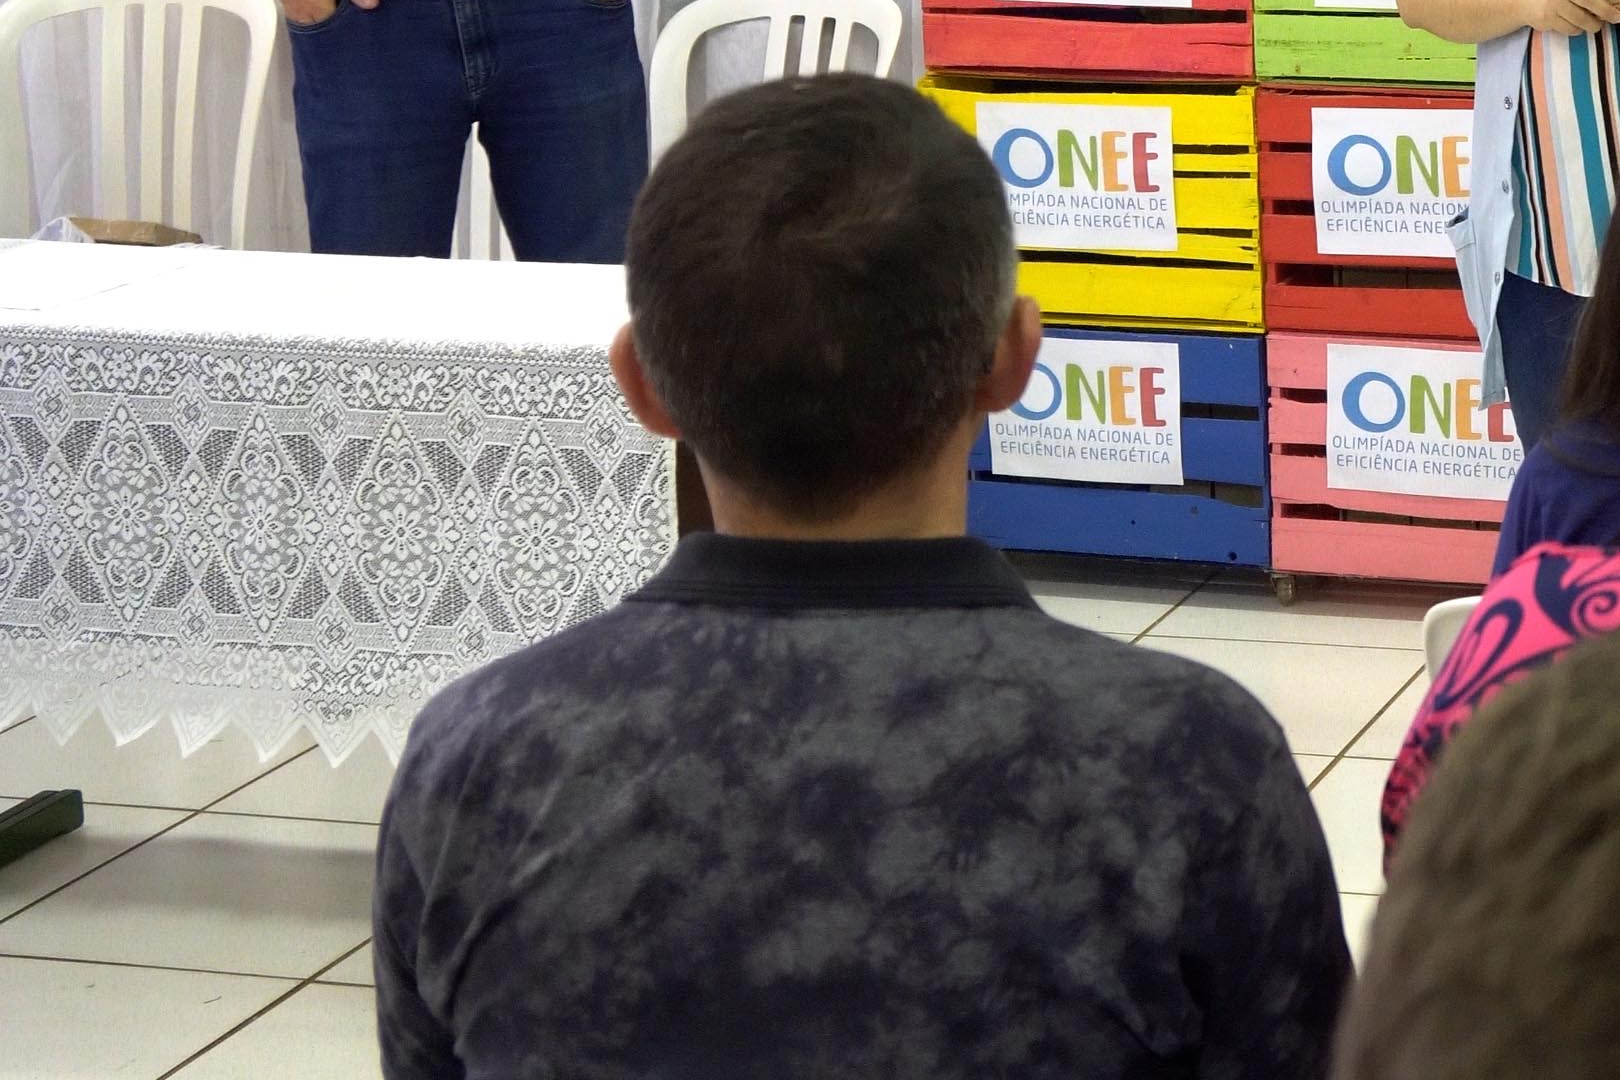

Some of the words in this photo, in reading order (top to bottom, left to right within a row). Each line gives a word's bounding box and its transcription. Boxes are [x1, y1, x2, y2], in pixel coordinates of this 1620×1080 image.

[992, 128, 1160, 193] ONEE
[1327, 134, 1471, 198] ONE
[1070, 195, 1145, 211] NACIONAL
[1149, 198, 1168, 211] DE
[1321, 199, 1405, 216] OLIMPÍADA
[1074, 212, 1165, 230] ENERGÉTICA
[1327, 217, 1408, 233] EFICIÊNCIA
[995, 419, 1072, 441] OLIMPÍADA
[1077, 428, 1151, 446] NACIONAL
[1155, 432, 1175, 446] DE
[1000, 440, 1076, 459] EFICIÊNCIA
[1080, 443, 1170, 464] ENERGÉTICA
[1332, 436, 1416, 455] OLIMPÍADA
[1420, 442, 1497, 461] NACIONAL
[1502, 447, 1522, 462] DE
[1336, 454, 1419, 474] EFICIÊNCIA
[1422, 460, 1518, 479] ENERGÉTICA
